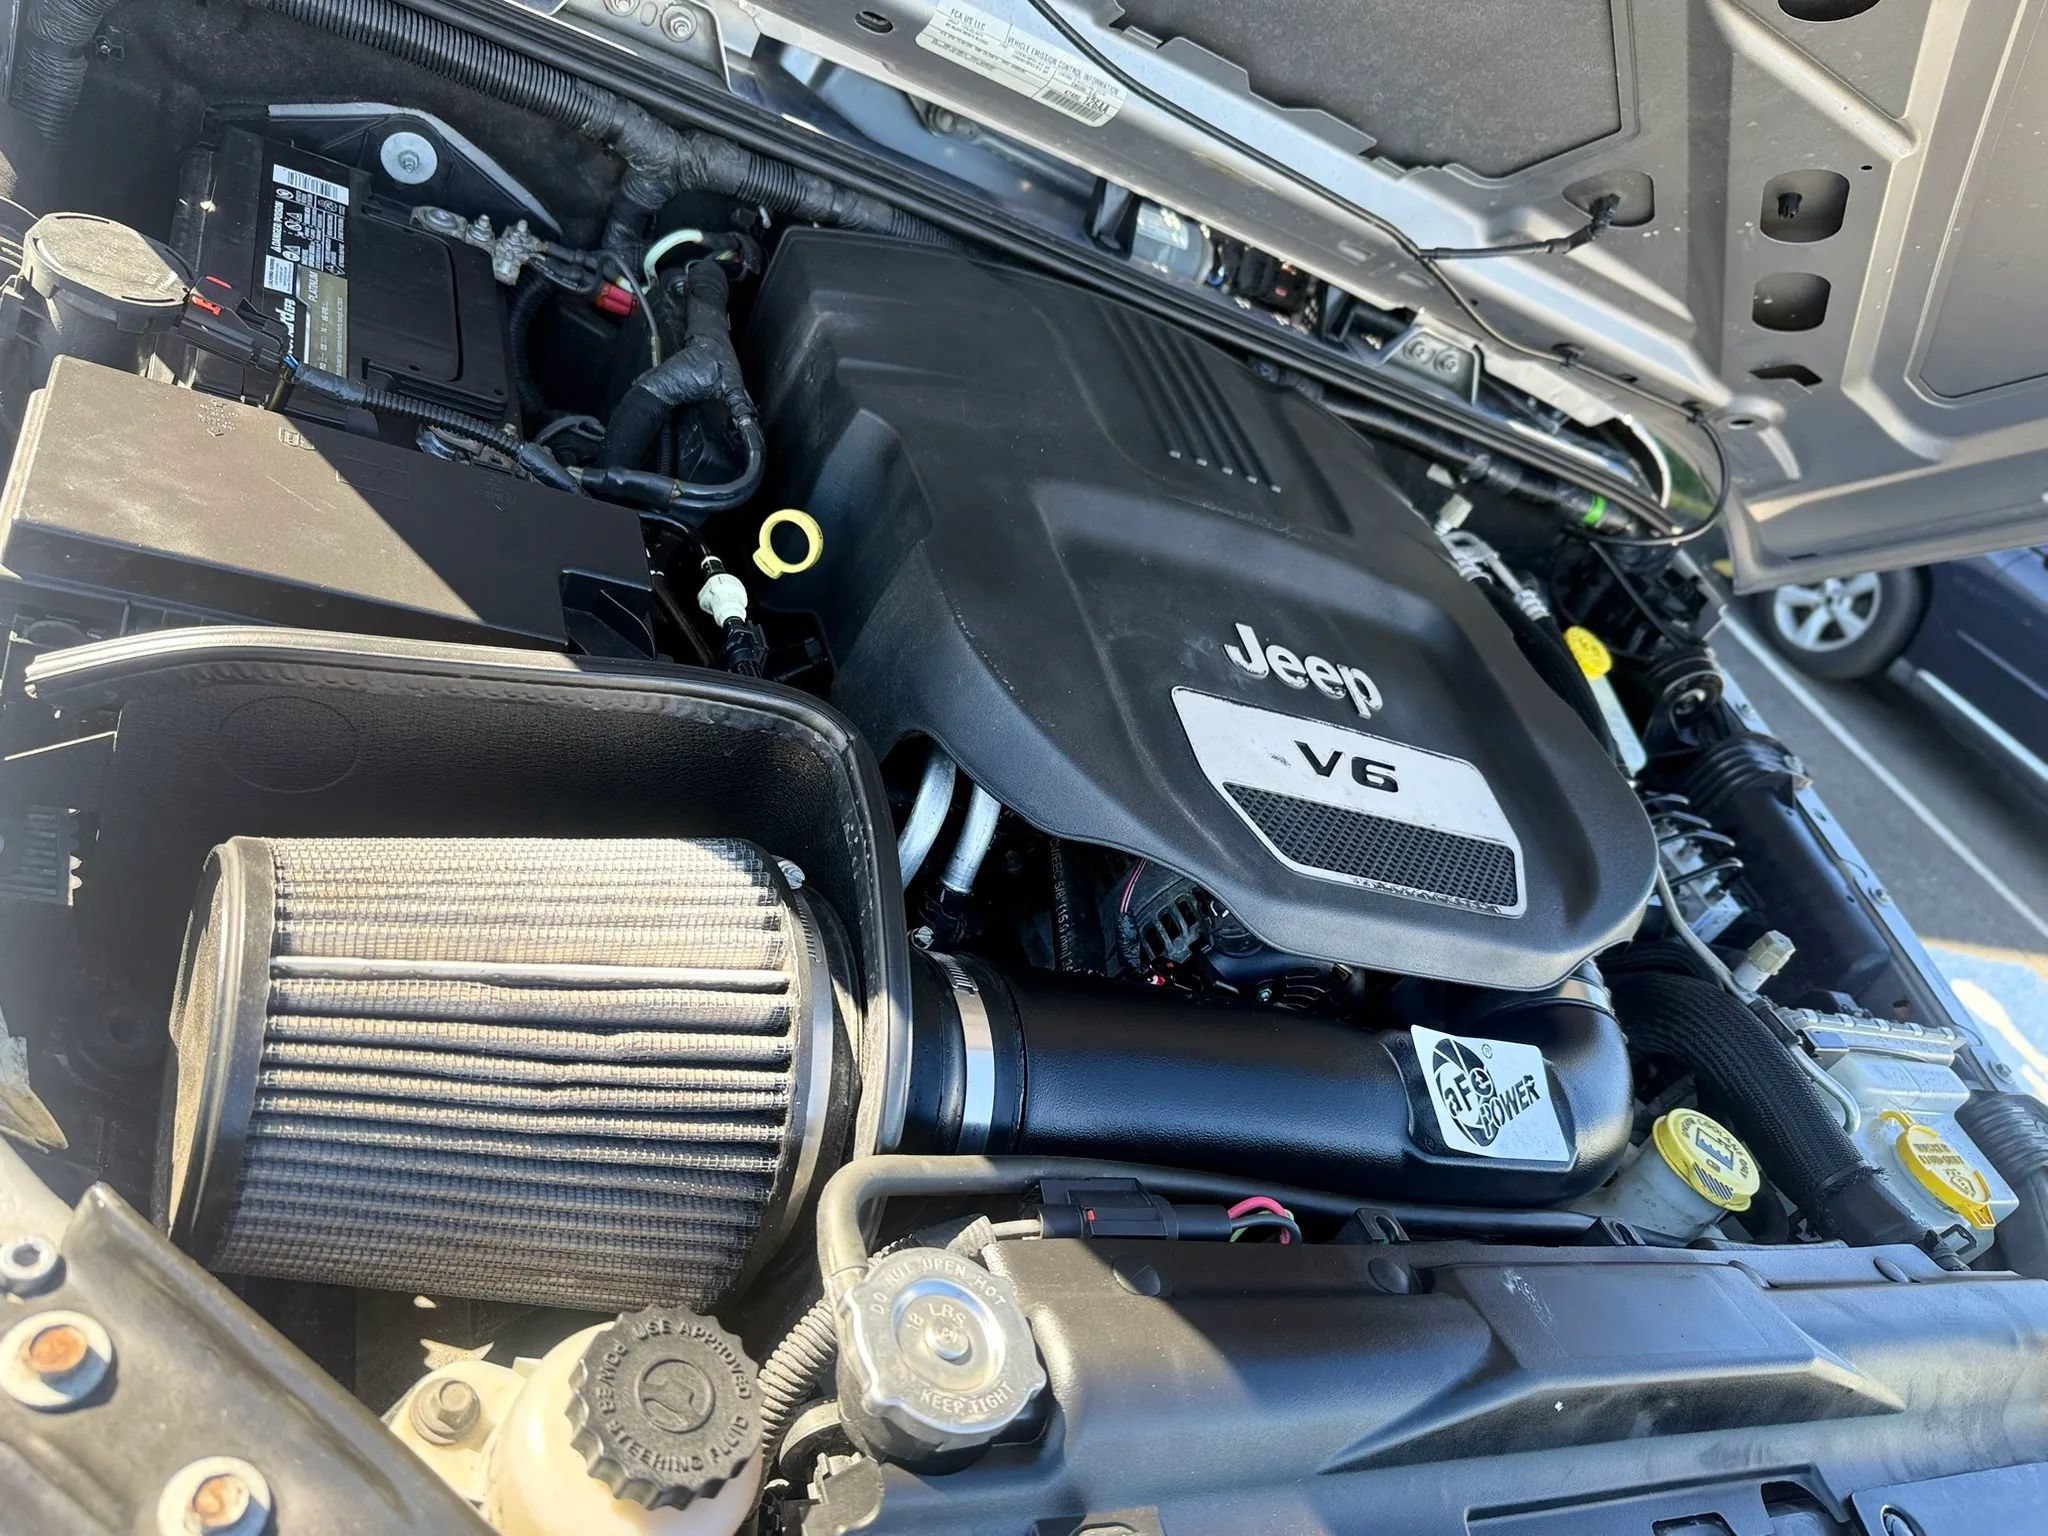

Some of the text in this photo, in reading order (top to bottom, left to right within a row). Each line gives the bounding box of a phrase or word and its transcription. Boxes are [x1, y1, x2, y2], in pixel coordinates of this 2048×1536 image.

[950, 8, 986, 31] FCA US LLC
[1007, 36, 1030, 52] VEHICLE
[1030, 47, 1058, 66] EMISSION
[1058, 60, 1082, 78] CONTROL
[1082, 73, 1119, 95] INFORMATION
[308, 271, 319, 303] PLATINUM
[1223, 622, 1383, 720] Jeep
[1293, 739, 1399, 793] V6
[1479, 1074, 1541, 1140] POWER
[870, 1291, 888, 1316] DO
[921, 1257, 967, 1277] OPEN
[973, 1274, 1008, 1306] HOT
[906, 1312, 925, 1331] 18
[633, 1319, 752, 1400] USE APPROVED
[595, 1340, 750, 1474] POWER STEERING FLUID
[919, 1380, 1016, 1414] KEEP TIGHT
